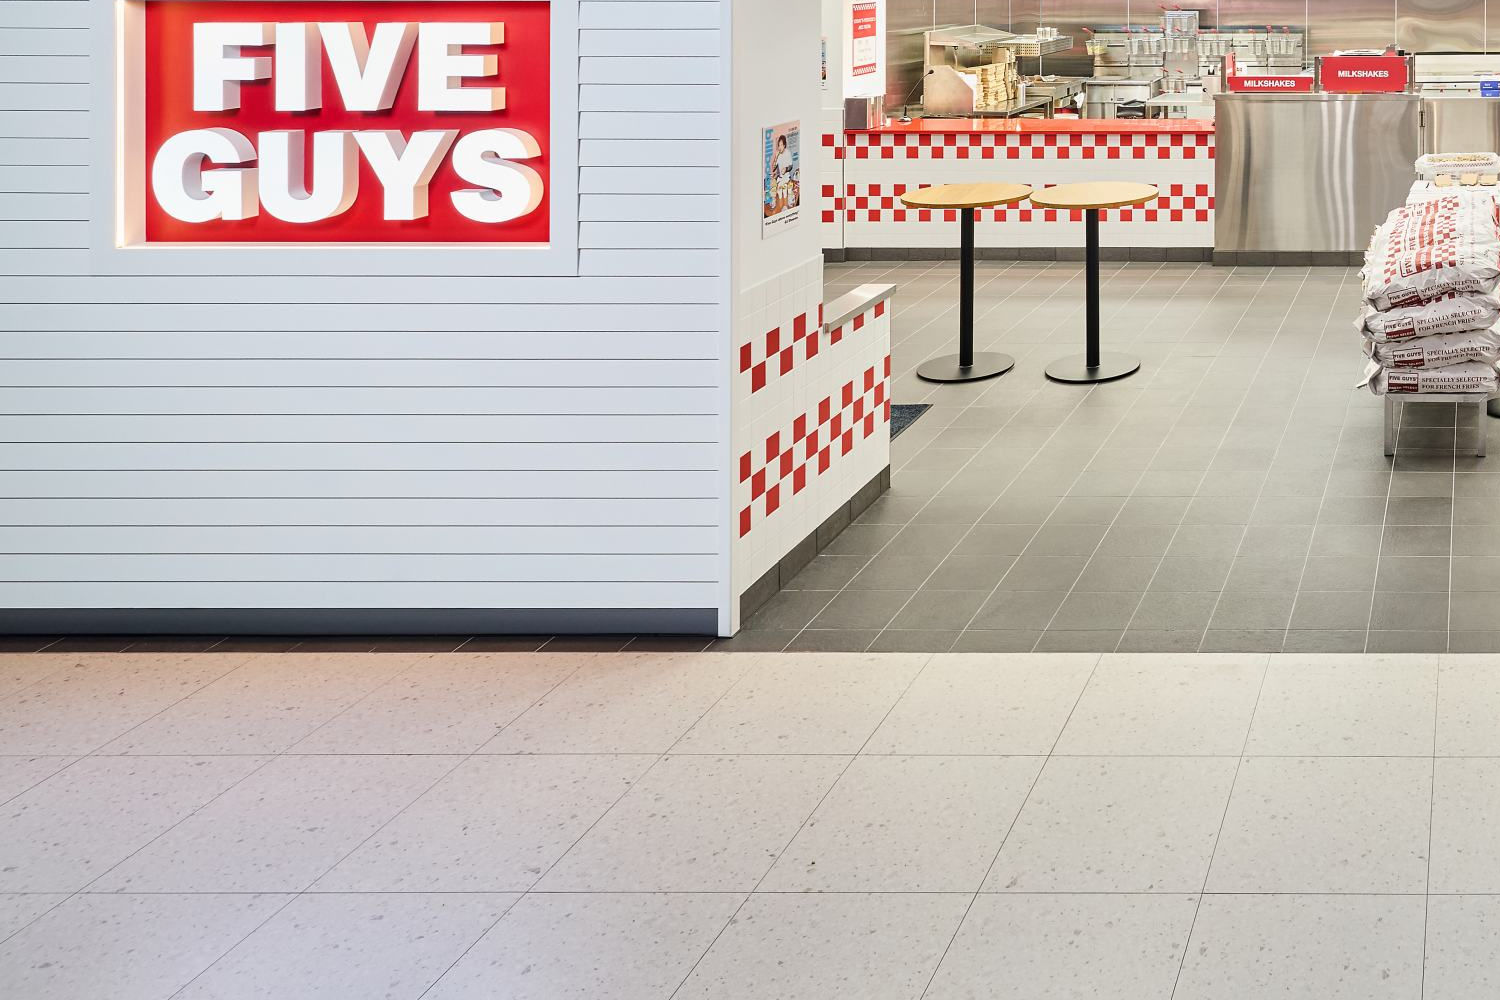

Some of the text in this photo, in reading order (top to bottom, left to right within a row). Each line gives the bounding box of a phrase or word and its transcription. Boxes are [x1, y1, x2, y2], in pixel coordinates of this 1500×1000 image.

[194, 21, 505, 112] FIVE
[1338, 70, 1389, 78] MILKSHAKES
[1244, 80, 1296, 88] MILKSHAKES
[152, 127, 544, 223] GUYS
[1416, 309, 1482, 325] SPECIALLY SELECTED
[1431, 320, 1457, 329] FRENCH
[1457, 317, 1476, 325] FRIES
[1426, 348, 1459, 356] SPECIALLY
